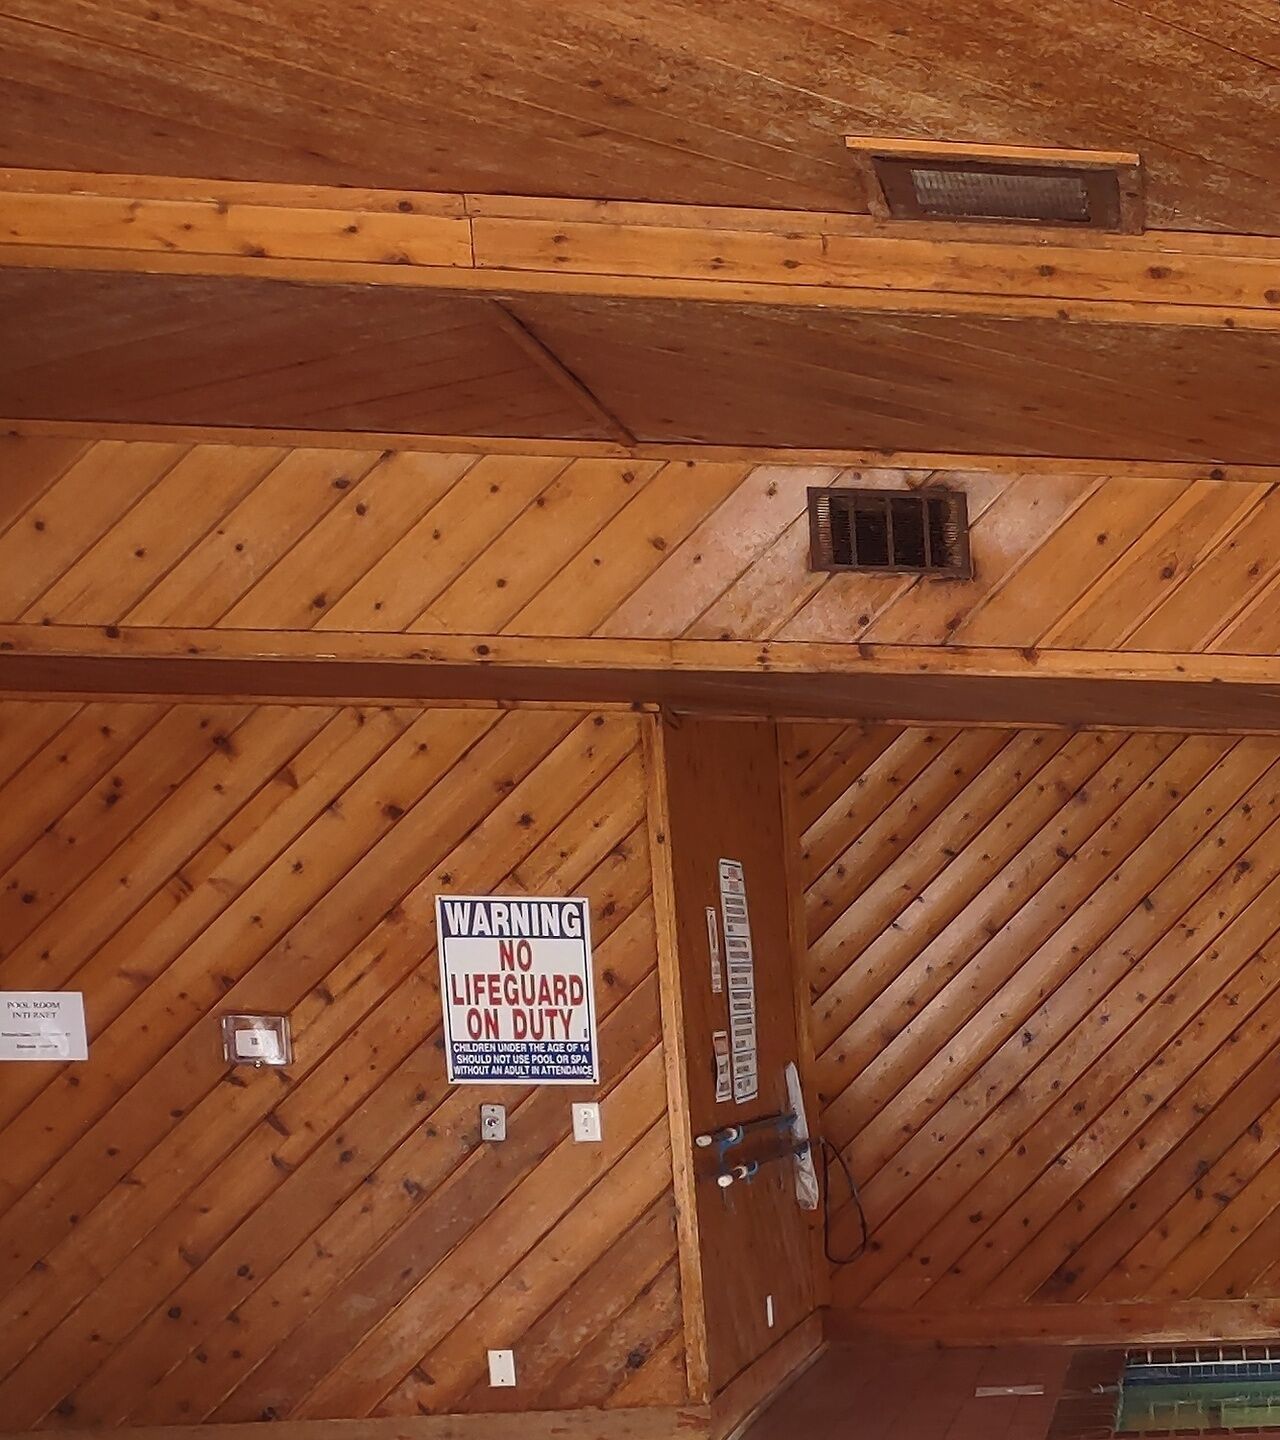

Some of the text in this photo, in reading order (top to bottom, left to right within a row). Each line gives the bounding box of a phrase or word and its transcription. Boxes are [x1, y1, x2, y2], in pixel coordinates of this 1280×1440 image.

[444, 902, 582, 938] WARNING
[499, 939, 533, 972] NO
[451, 974, 584, 1006] LIFEGUARD
[7, 1001, 60, 1009] POOL ROOM
[467, 1008, 573, 1041] ON DUTY
[453, 1043, 589, 1053] CHILDREN UNDER THE AGE OF 14
[457, 1054, 588, 1064] SHOULD NOT USE POOL OR SPA
[454, 1065, 593, 1076] WITHOUT AN ADULT IN ATTENDANCE
